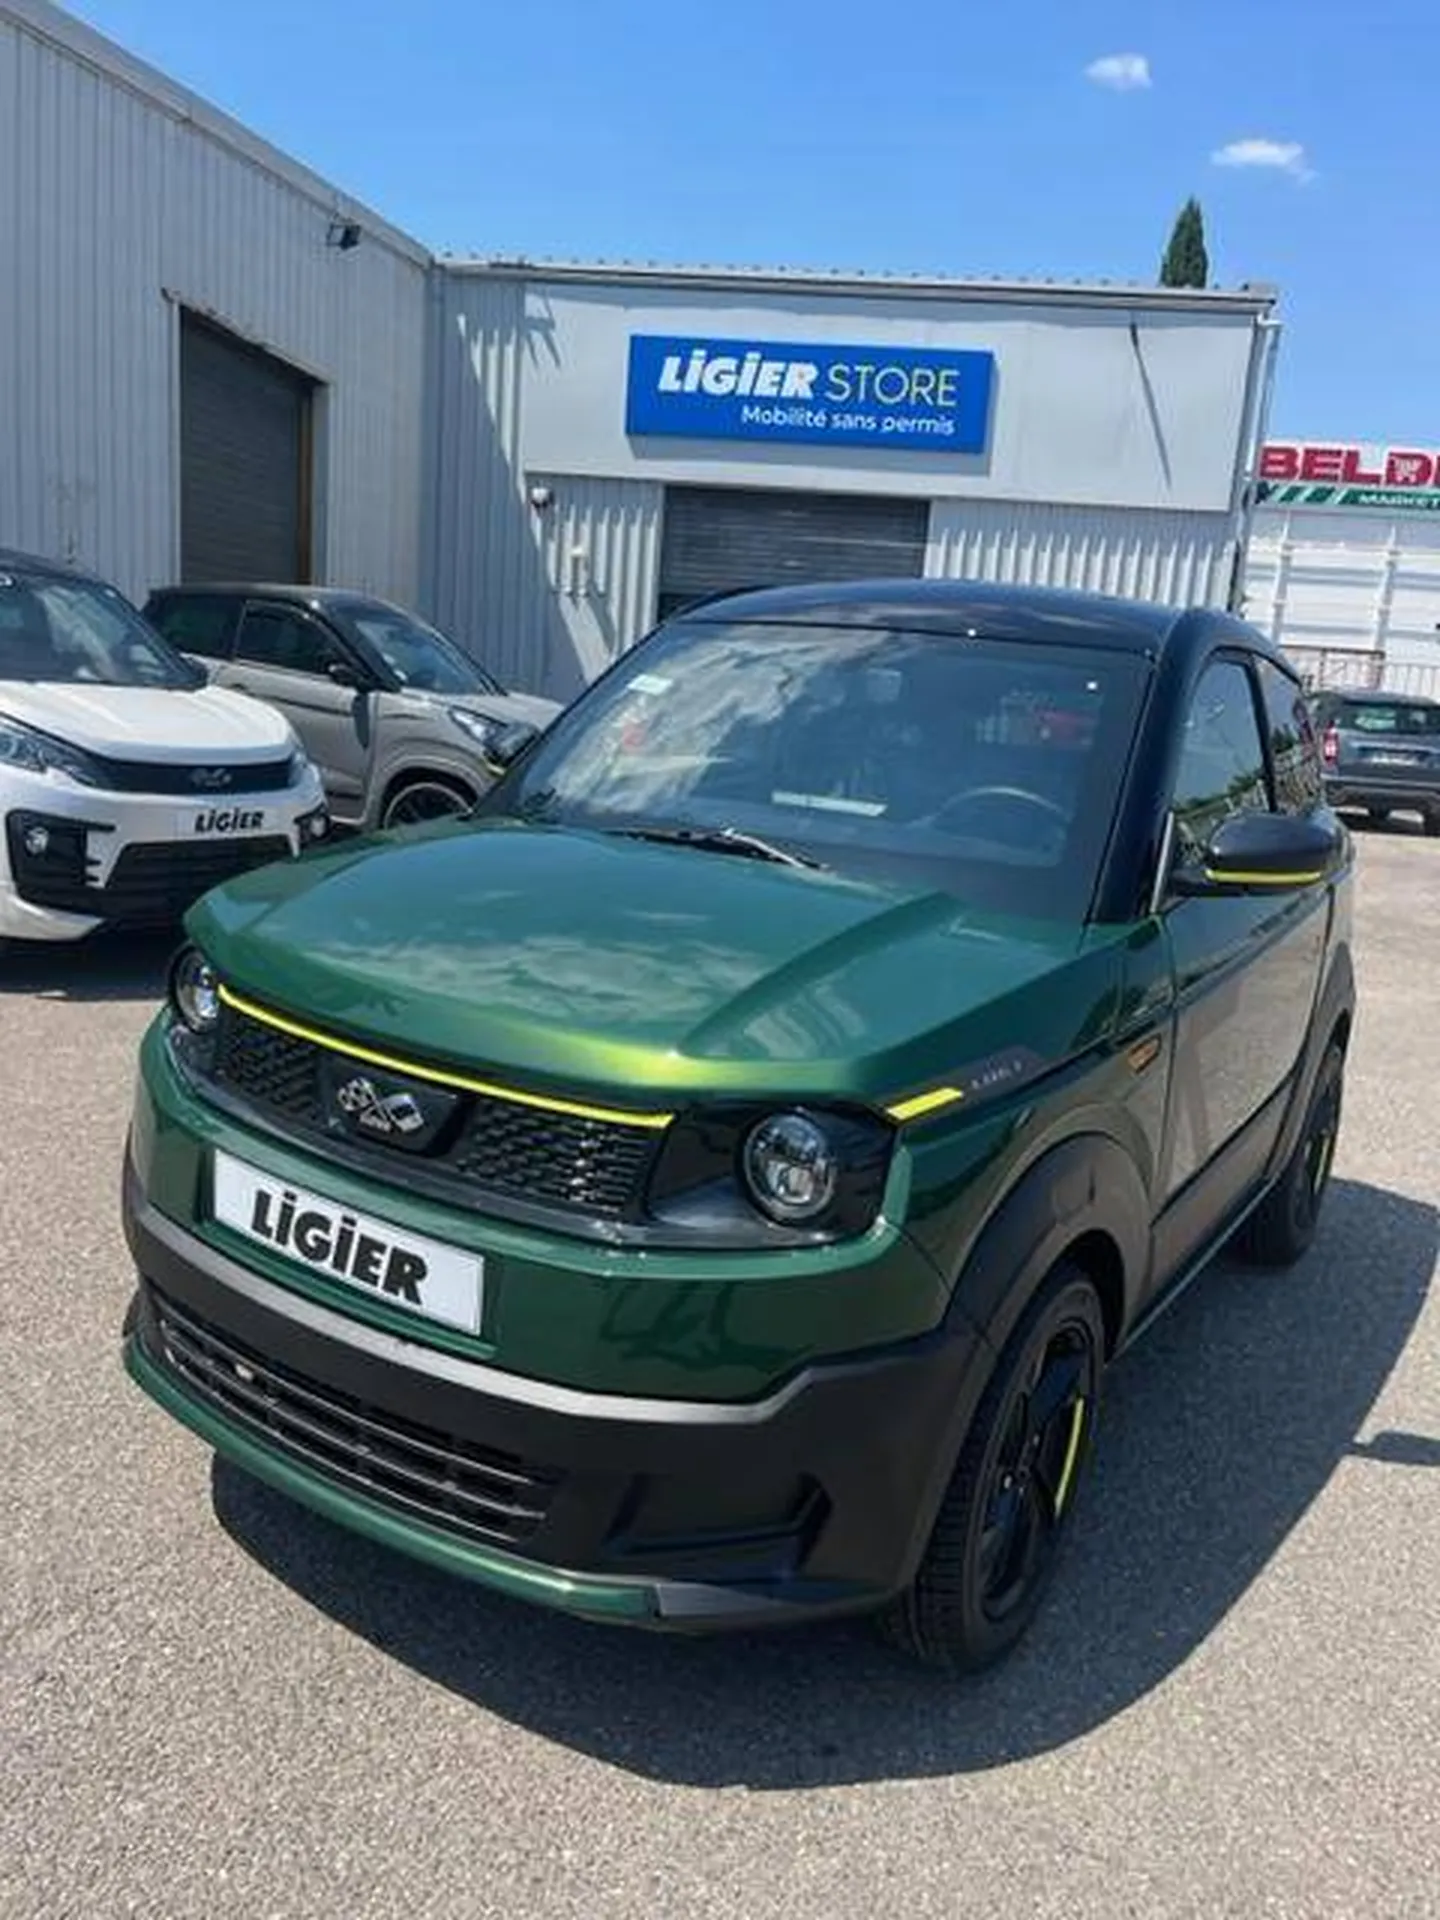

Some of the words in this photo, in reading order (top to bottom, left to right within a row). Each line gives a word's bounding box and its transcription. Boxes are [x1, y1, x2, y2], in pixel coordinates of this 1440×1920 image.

[824, 363, 960, 407] STORE
[741, 404, 827, 428] Mobilité
[831, 413, 876, 430] sans
[881, 414, 954, 435] permis
[1260, 447, 1440, 488] BELD
